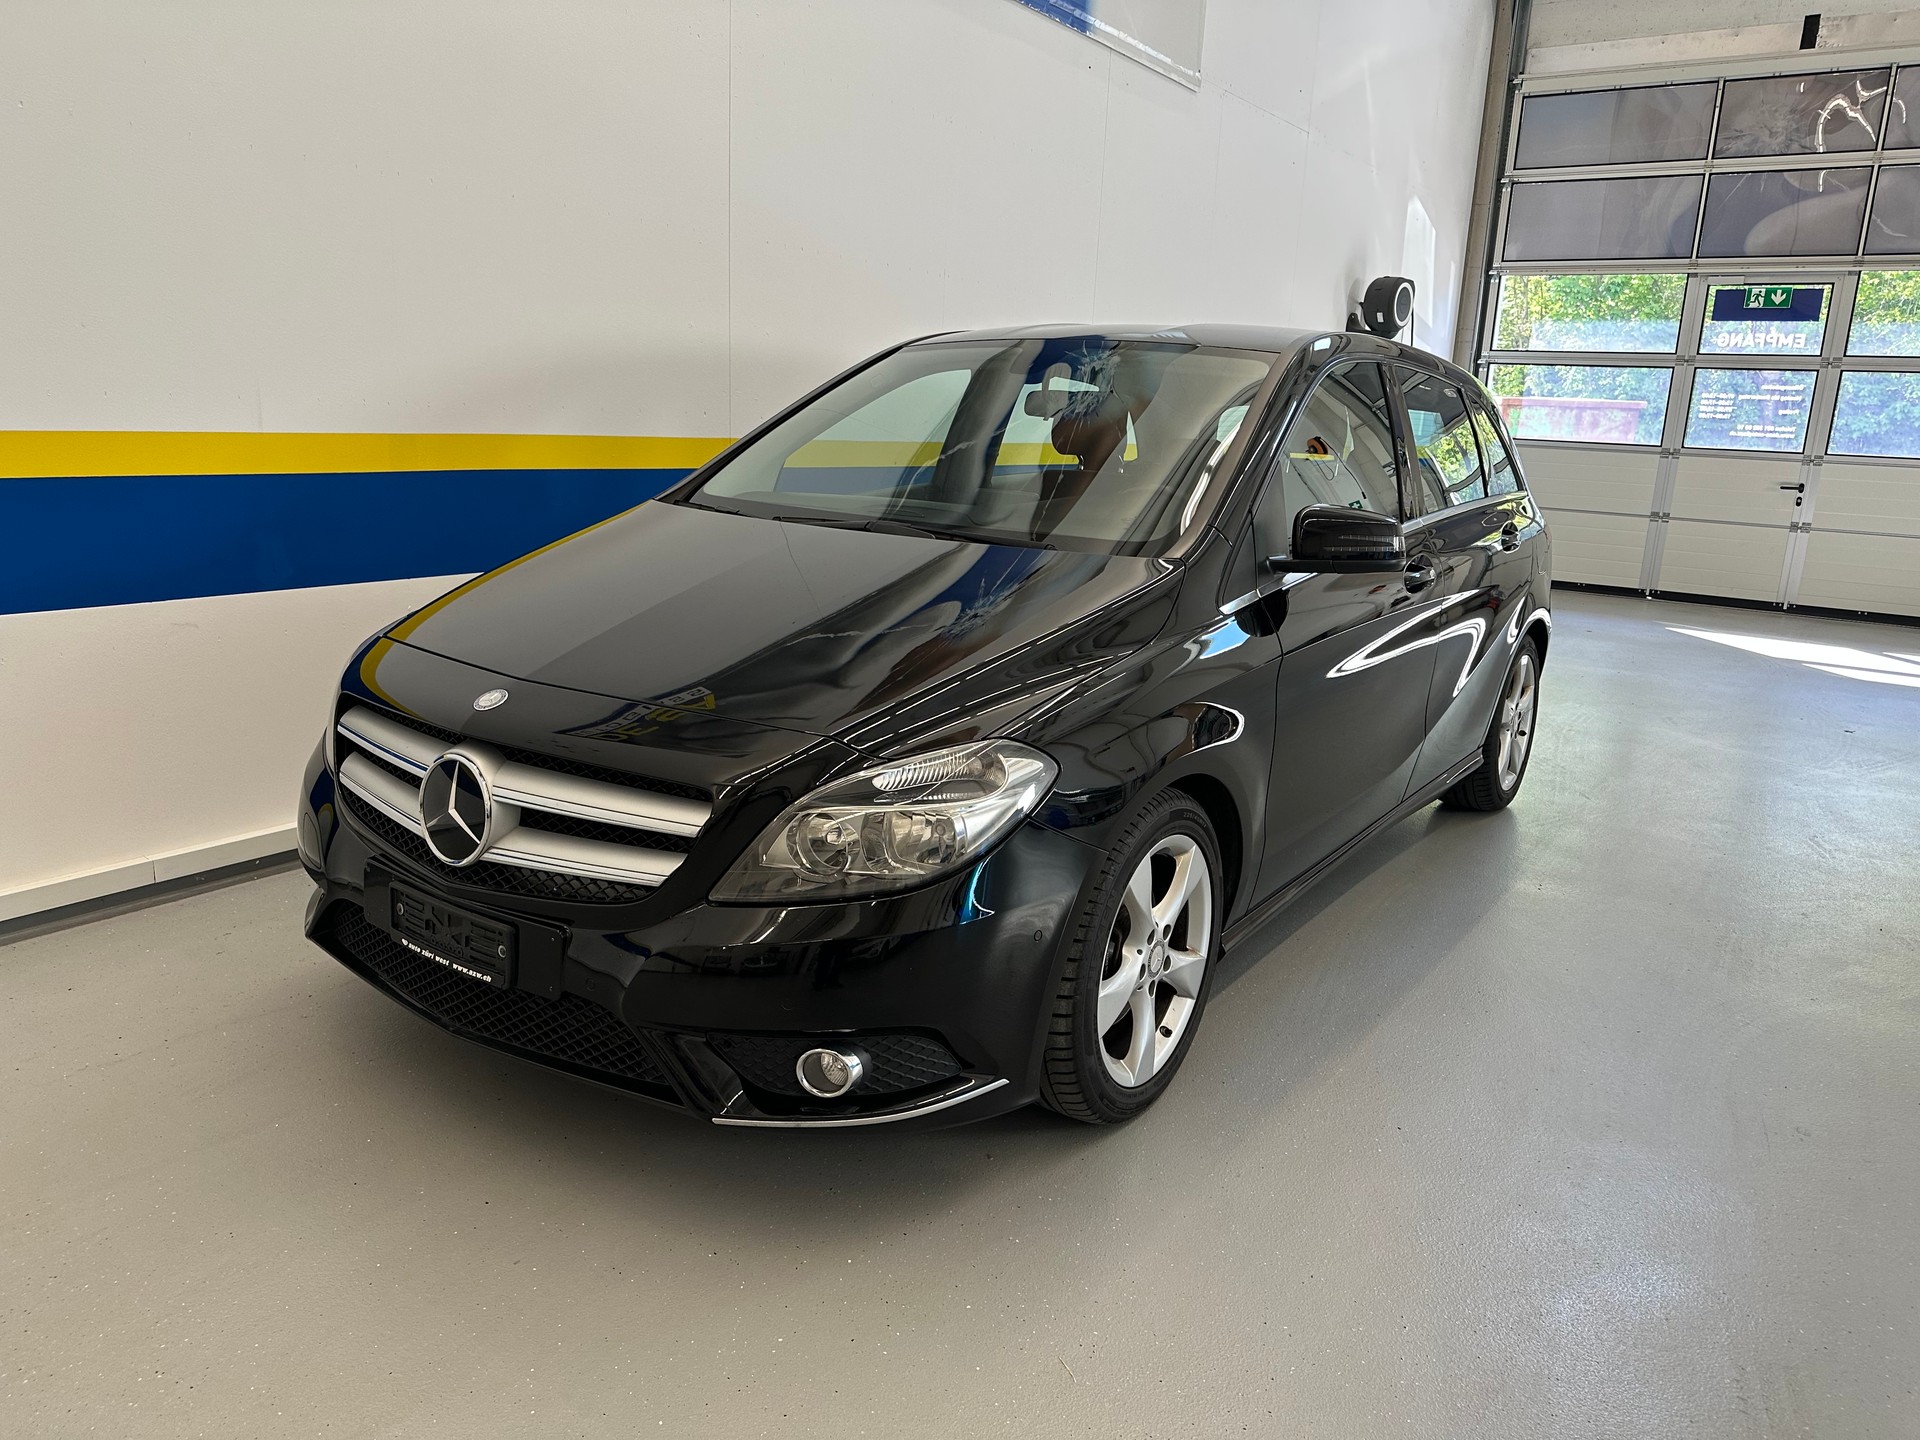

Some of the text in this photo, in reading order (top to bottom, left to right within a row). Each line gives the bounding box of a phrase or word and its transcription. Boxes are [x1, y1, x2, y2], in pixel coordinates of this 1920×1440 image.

[408, 943, 421, 953] auto
[435, 955, 449, 966] west
[452, 963, 492, 982] www.azw.ch
